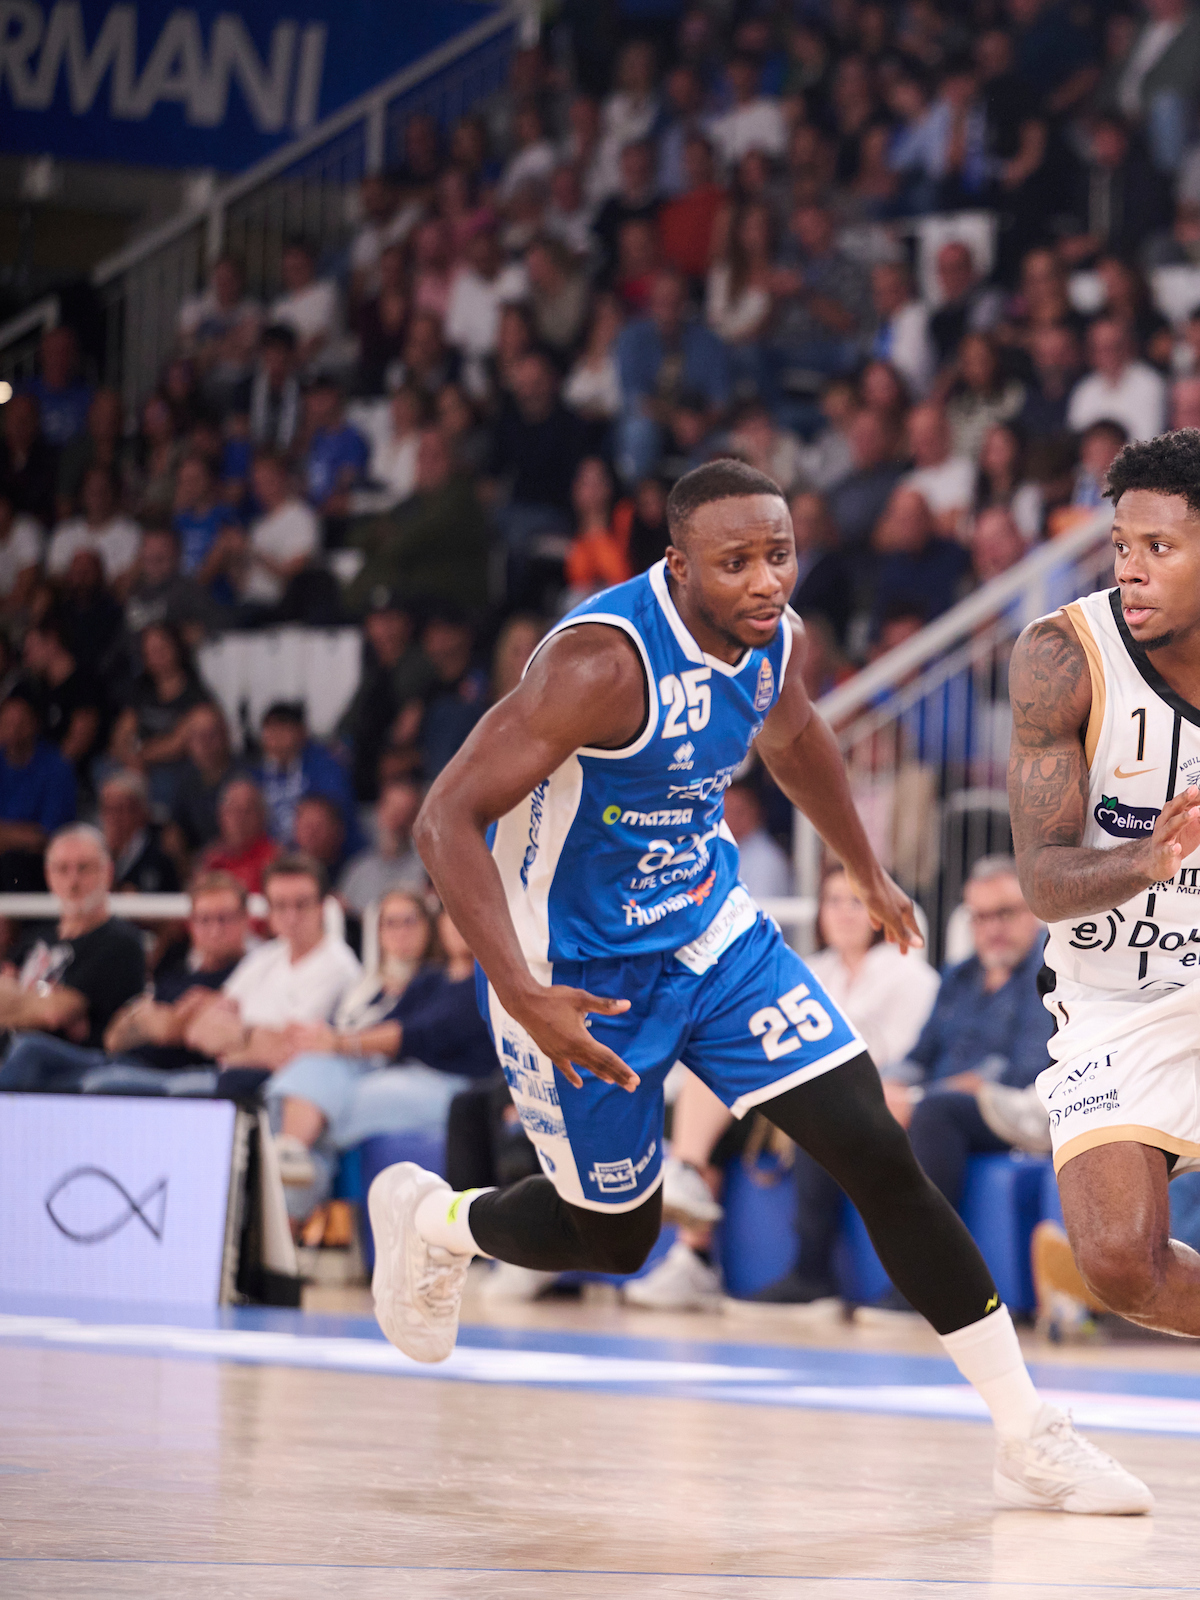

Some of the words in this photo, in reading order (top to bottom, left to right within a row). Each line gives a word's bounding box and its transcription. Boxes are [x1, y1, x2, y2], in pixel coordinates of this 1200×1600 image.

[658, 666, 713, 739] 25
[1131, 707, 1147, 762] 1
[1097, 808, 1156, 832] Melind
[630, 875, 657, 890] LIFE
[748, 982, 834, 1062] 25
[1082, 1101, 1121, 1115] energia
